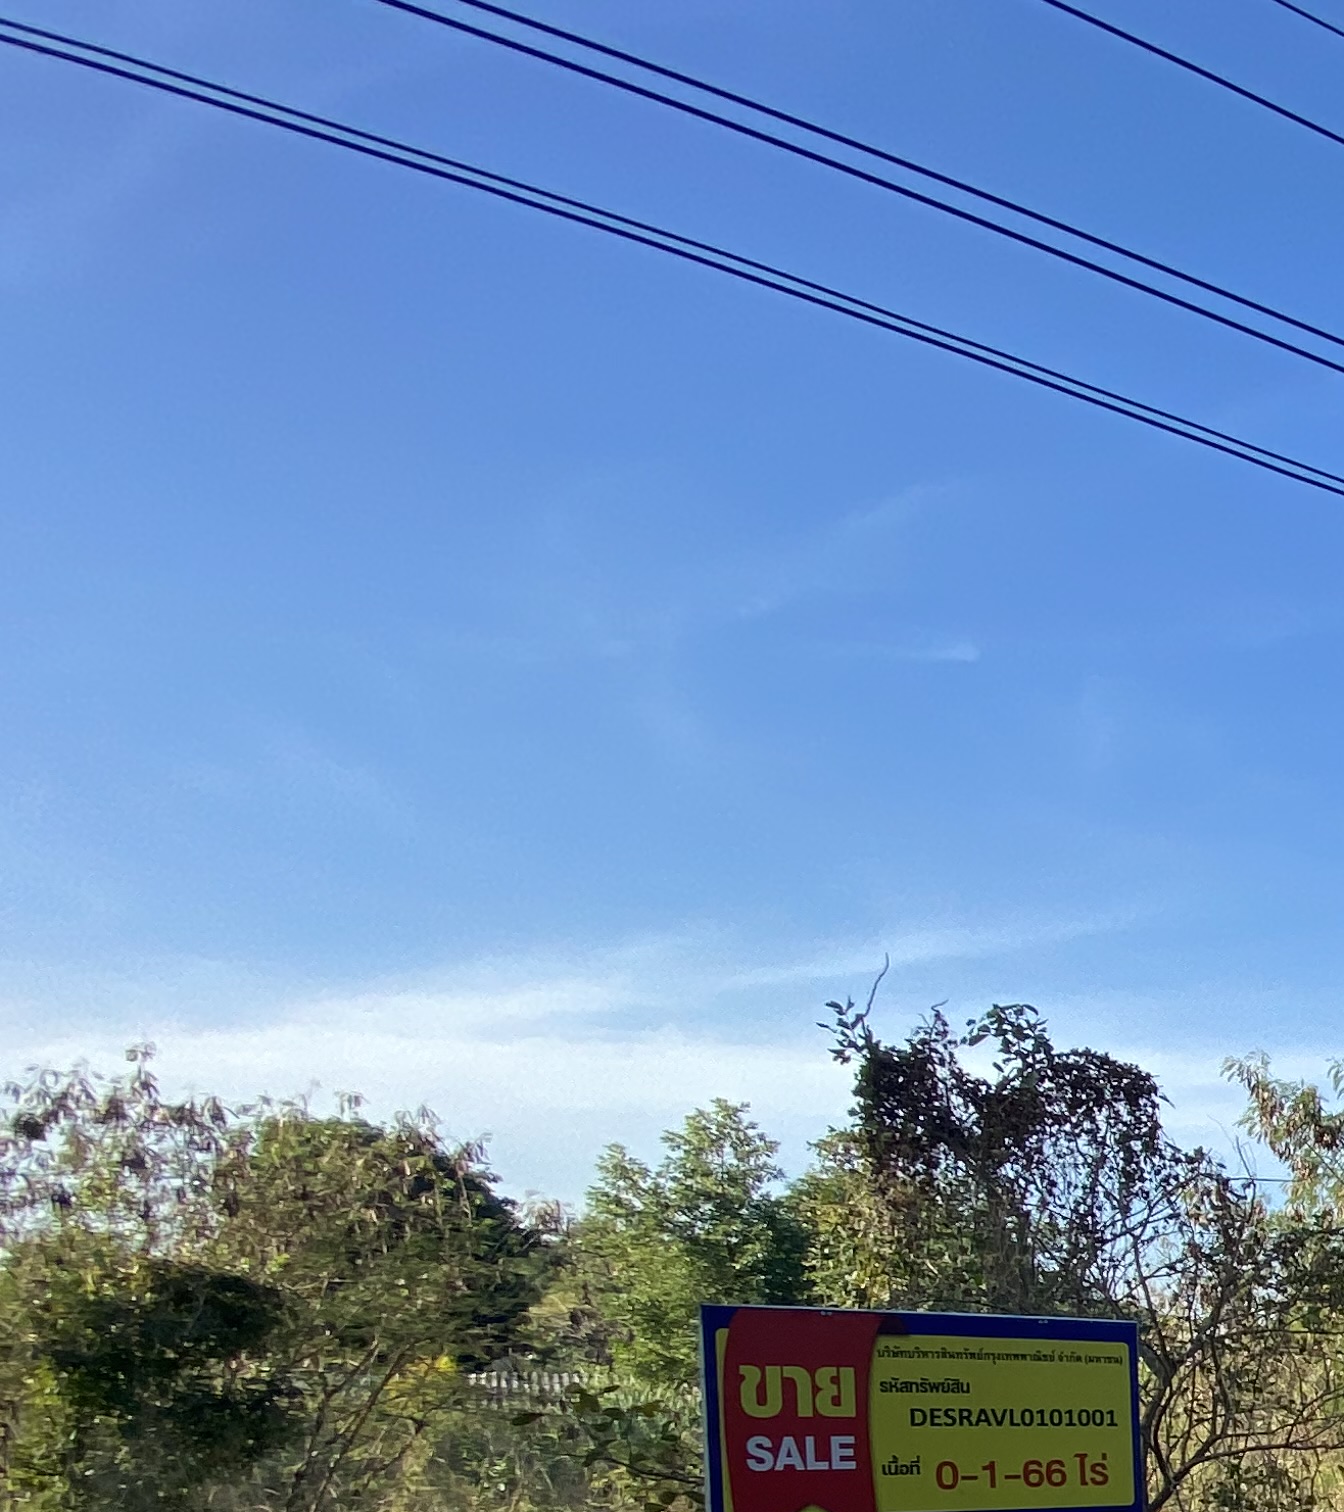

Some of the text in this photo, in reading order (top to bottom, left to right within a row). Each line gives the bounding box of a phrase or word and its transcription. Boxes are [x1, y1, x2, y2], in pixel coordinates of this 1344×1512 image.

[738, 1364, 857, 1420] ขาย
[879, 1376, 971, 1395] รหัสทรัพย์สิน
[909, 1407, 1119, 1428] DESRAVL0101001
[745, 1435, 857, 1472] SALE
[881, 1452, 1110, 1491] เนื้อที่ 0-1-66 ไร่
